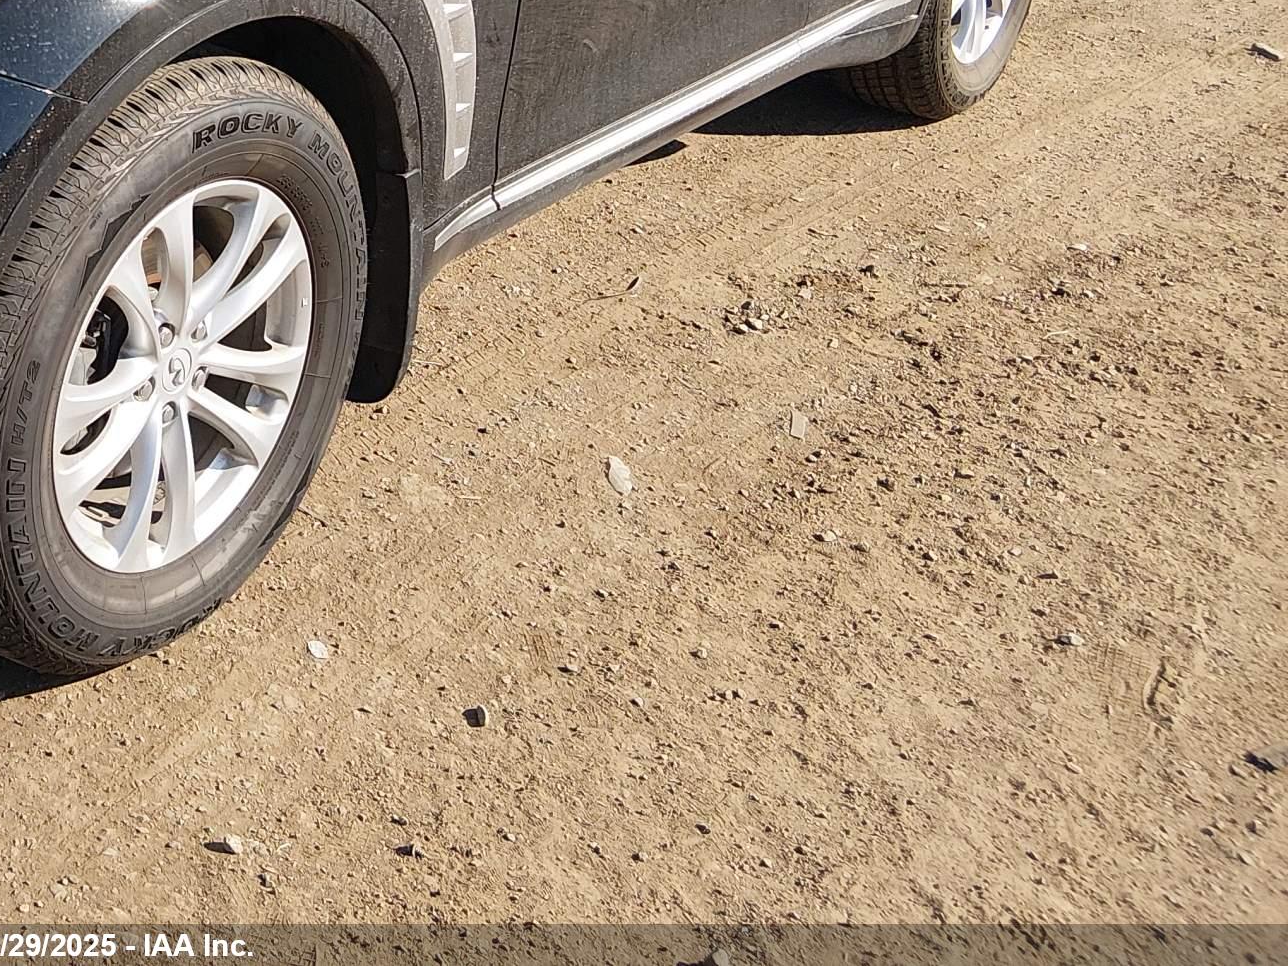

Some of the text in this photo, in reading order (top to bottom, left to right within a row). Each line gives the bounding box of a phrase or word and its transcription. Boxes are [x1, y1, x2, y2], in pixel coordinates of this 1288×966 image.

[191, 111, 303, 154] ROCKY
[11, 359, 41, 446] H/T2
[6, 457, 100, 653] MOUNTAIN
